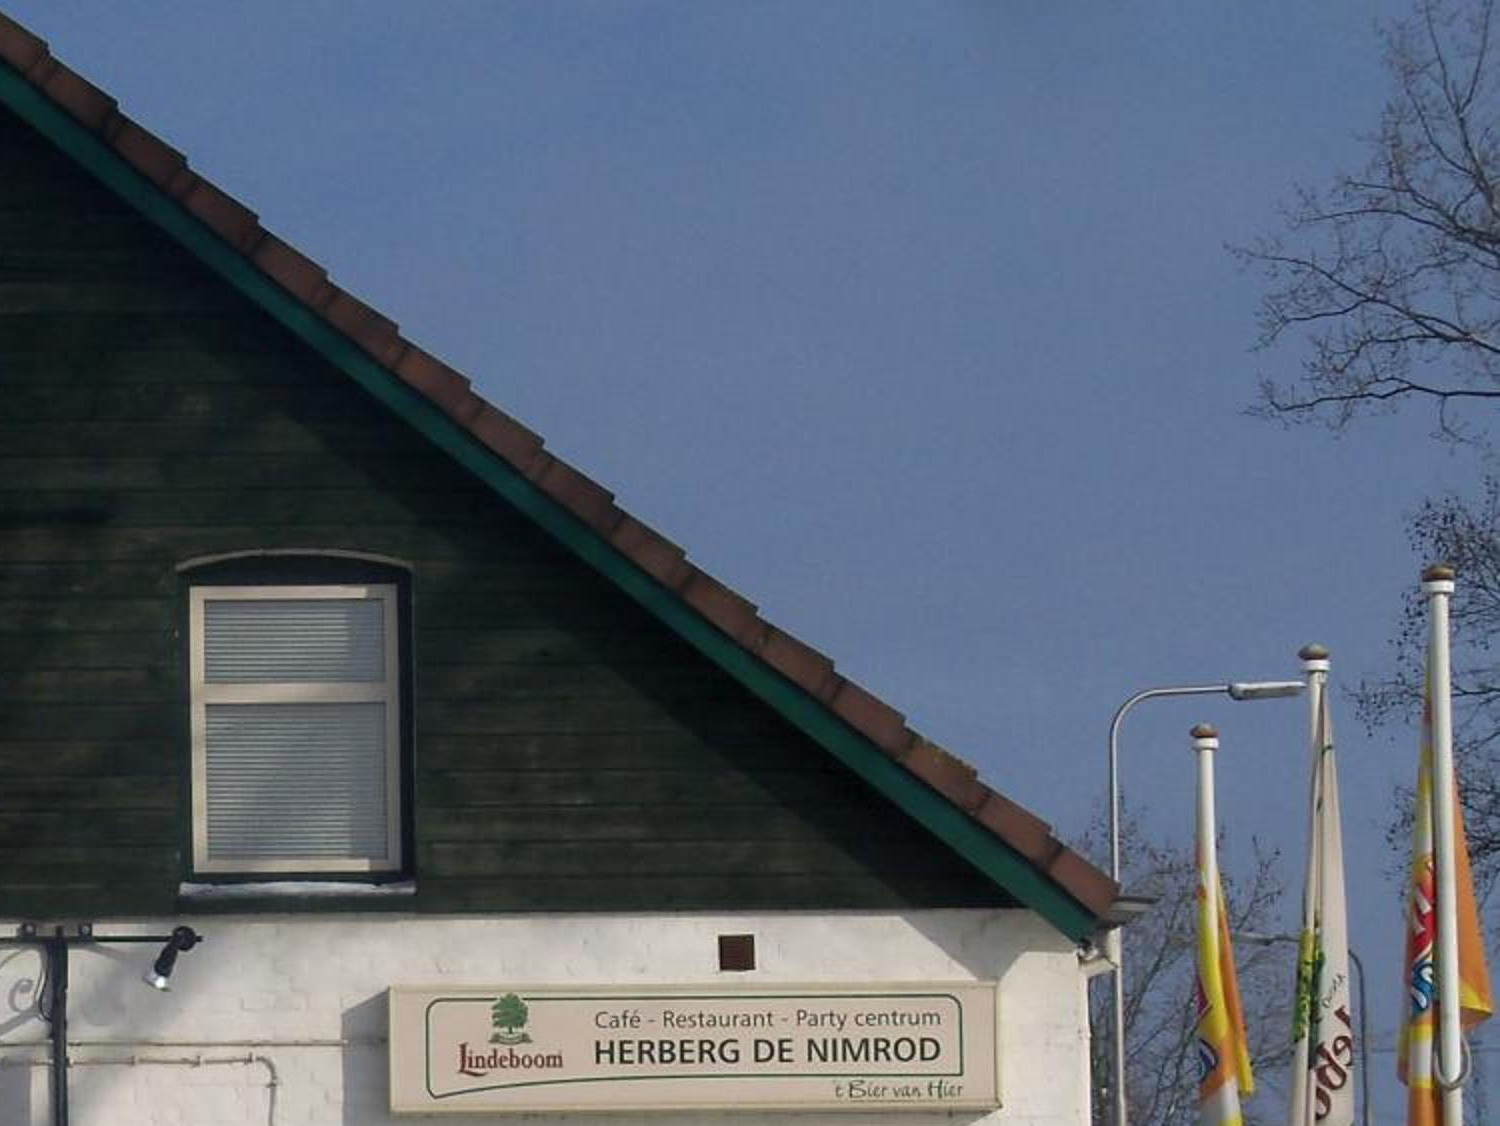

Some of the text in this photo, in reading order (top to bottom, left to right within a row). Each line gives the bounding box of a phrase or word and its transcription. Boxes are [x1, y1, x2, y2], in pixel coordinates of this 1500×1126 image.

[595, 1010, 642, 1029] Café
[662, 1010, 774, 1028] Restaurant
[796, 1009, 847, 1032] Party
[855, 1009, 941, 1027] centrum
[456, 1041, 564, 1077] Lindeboom
[595, 1037, 942, 1065] HERBERG DE NIMROD
[849, 1080, 886, 1098] Bier
[892, 1085, 922, 1098] van
[927, 1080, 963, 1099] Hier
